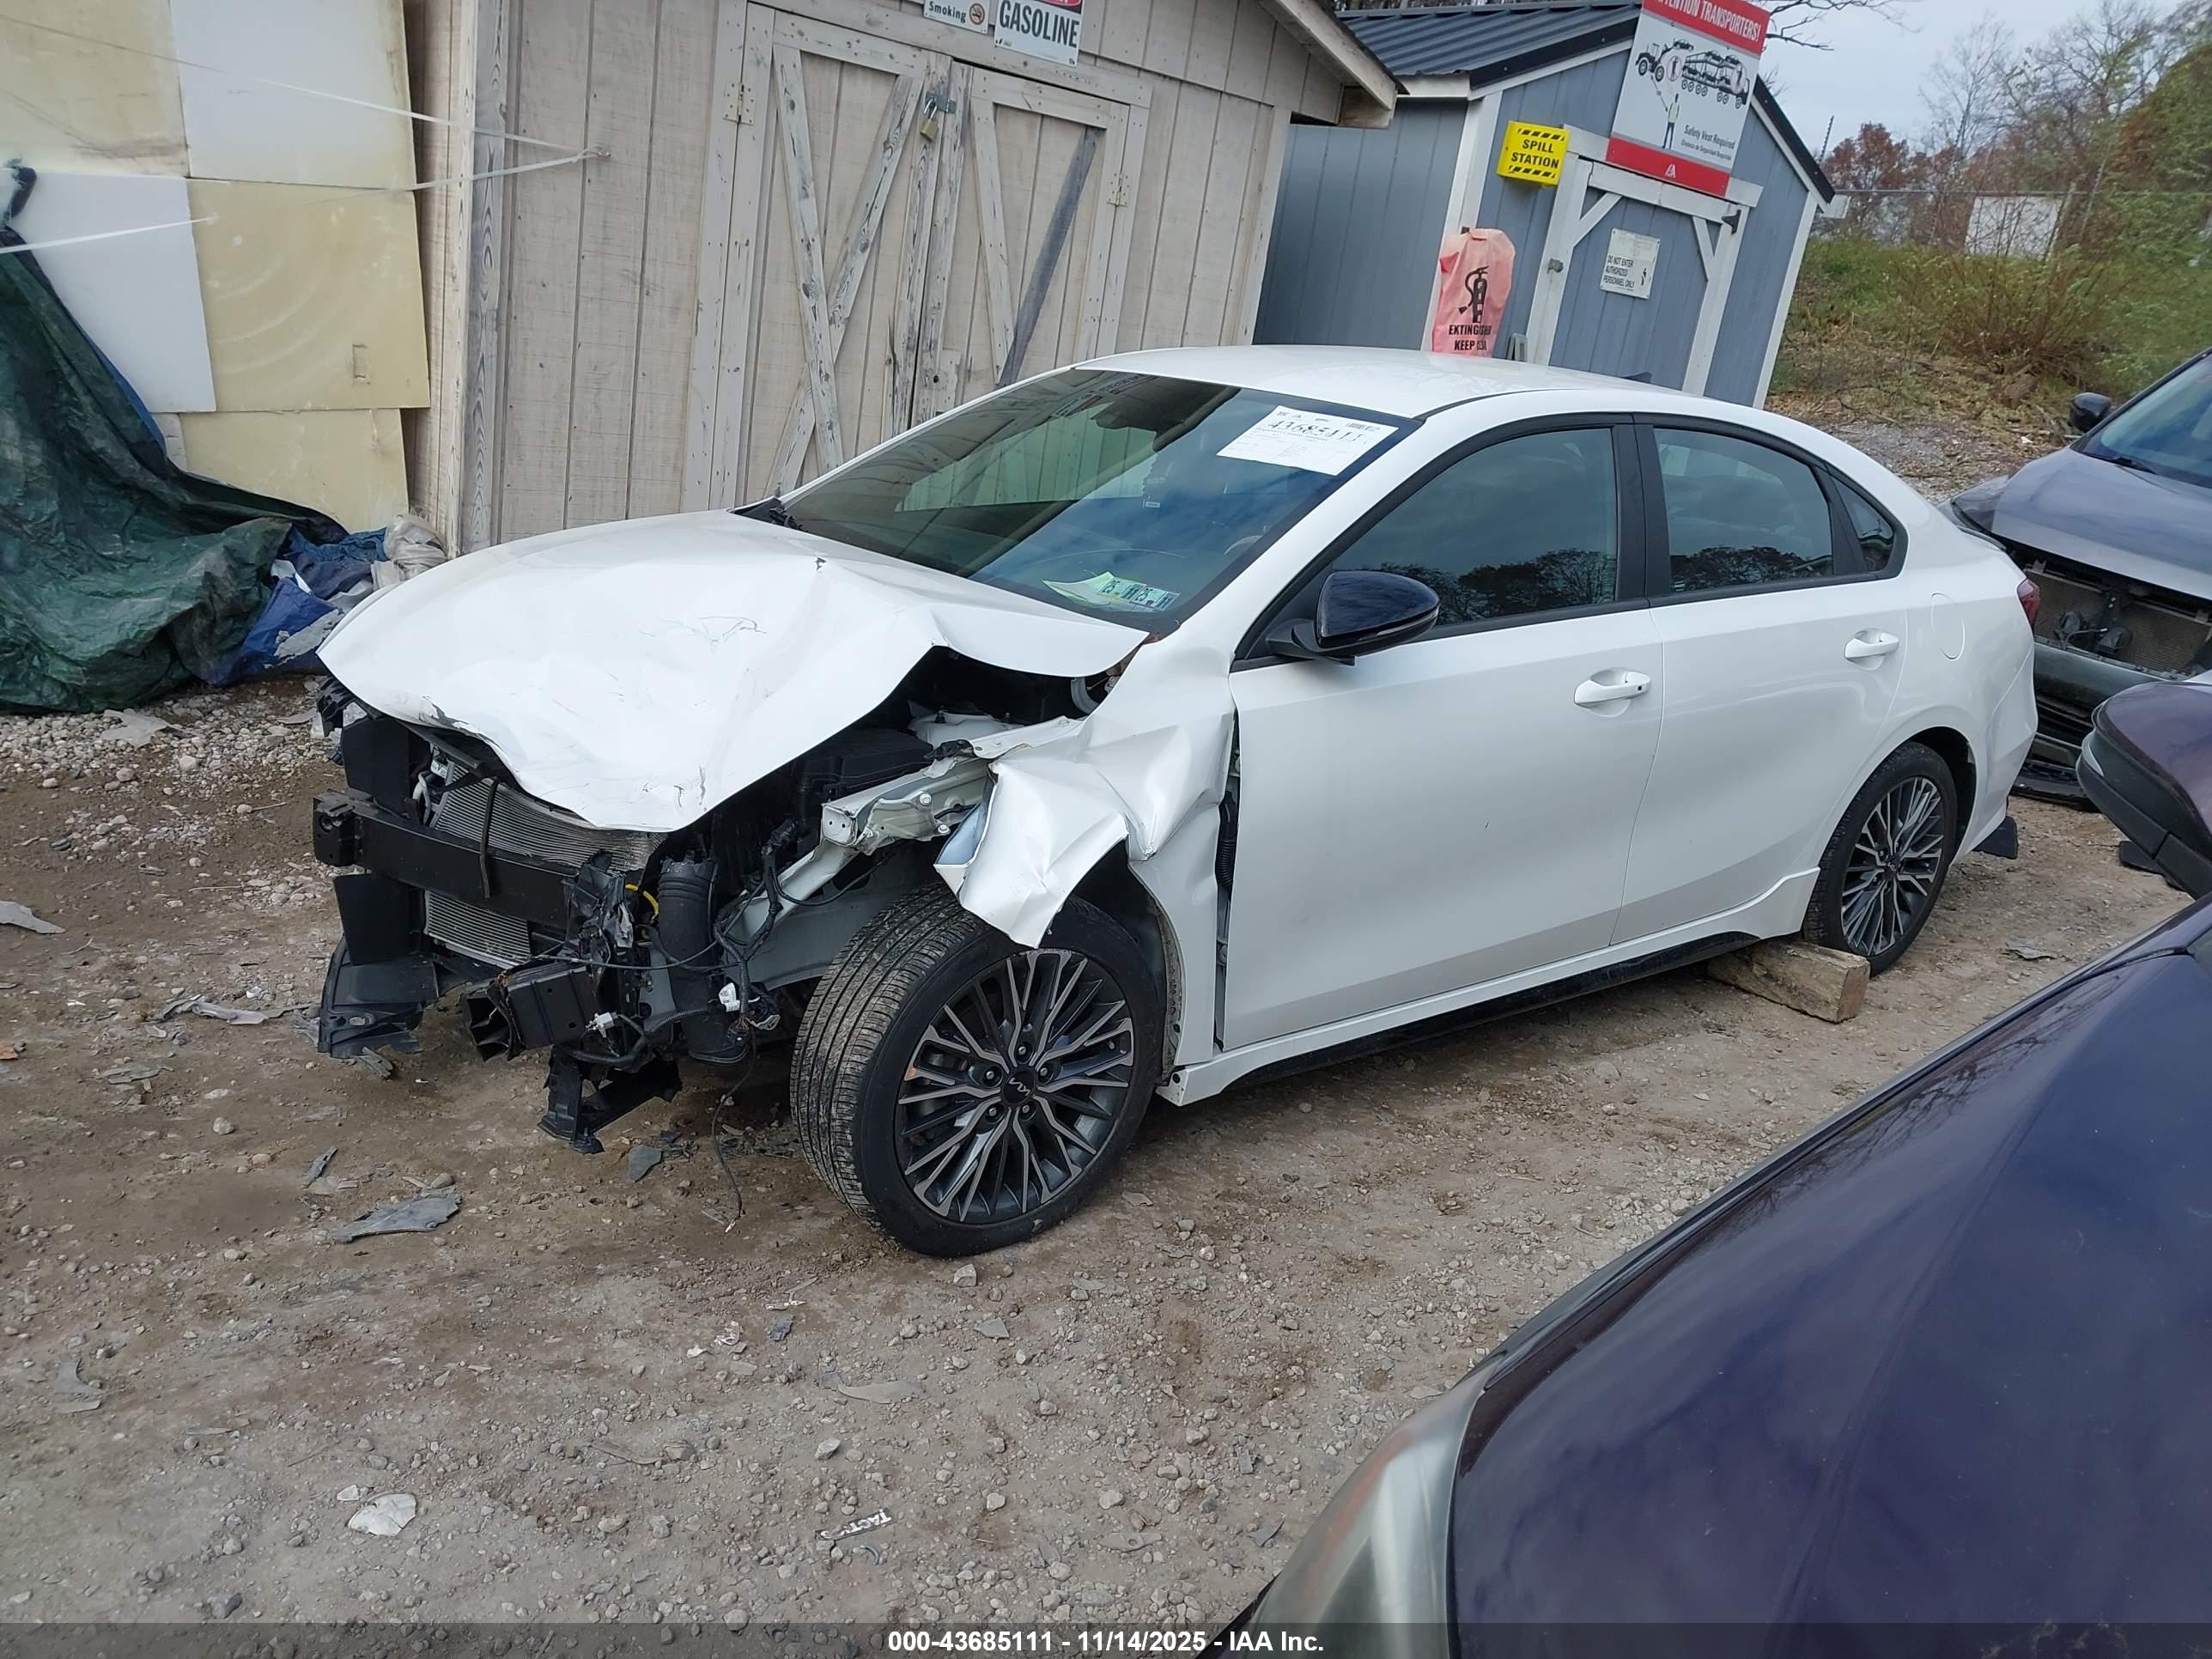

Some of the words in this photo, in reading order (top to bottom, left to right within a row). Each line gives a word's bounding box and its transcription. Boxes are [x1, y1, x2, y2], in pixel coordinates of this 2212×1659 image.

[928, 1, 967, 23] Smoking
[999, 0, 1079, 48] GASOLINE
[1701, 2, 1761, 42] TRANSPORTERS!
[1684, 125, 1700, 141] Safety
[1522, 139, 1553, 153] SPILL
[1511, 152, 1559, 168] STATION
[1454, 339, 1475, 351] KEEP
